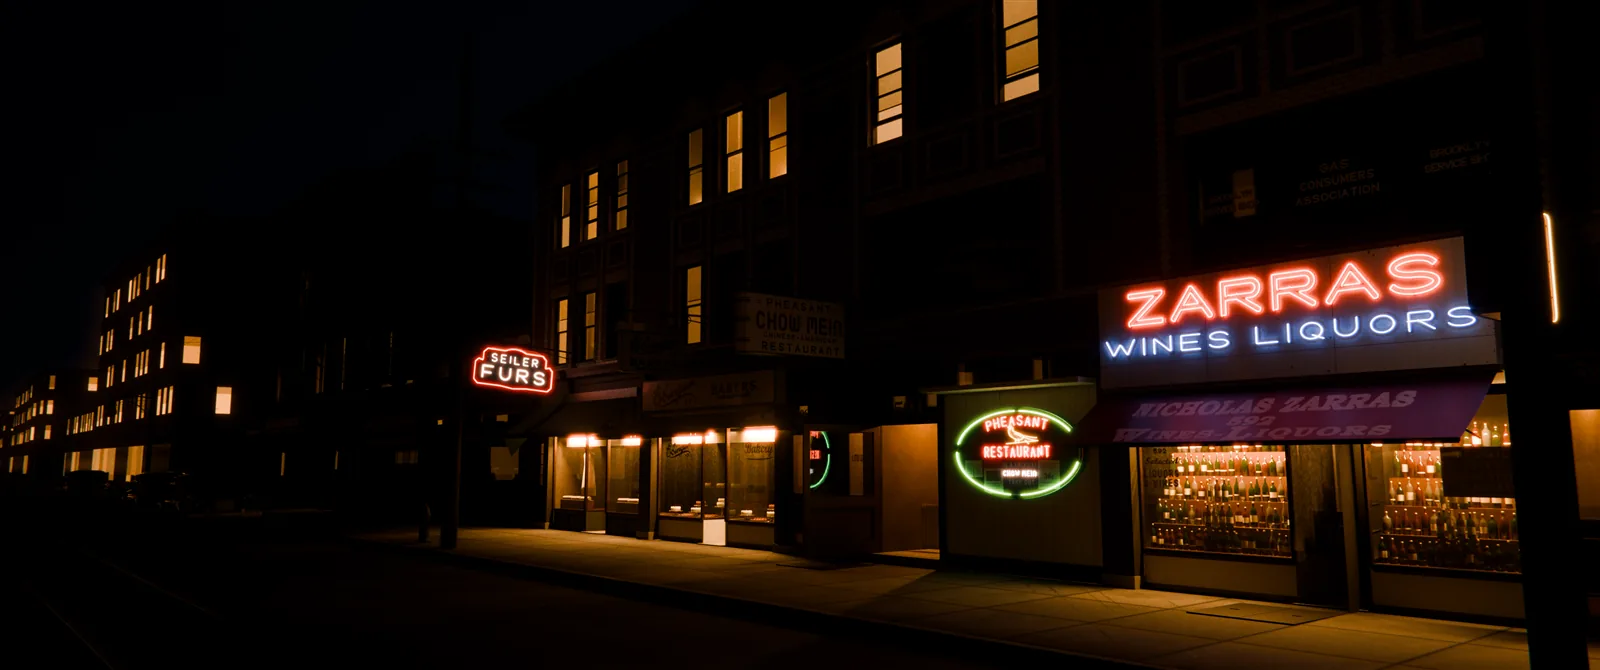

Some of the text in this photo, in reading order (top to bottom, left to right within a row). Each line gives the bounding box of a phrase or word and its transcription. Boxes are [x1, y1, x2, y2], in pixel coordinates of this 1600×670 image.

[1319, 158, 1350, 174] GAS
[1424, 157, 1468, 173] SERVICE
[1299, 168, 1375, 192] CONSUMERS
[1295, 181, 1380, 207] ASSOCIATION
[1125, 252, 1443, 328] ZARRAS
[766, 298, 831, 313] PHEASANT
[756, 310, 843, 337] CHOW MEIN
[1105, 306, 1477, 357] WINES LIQUORS
[762, 341, 839, 356] RESTAURANT
[491, 353, 540, 369] SEILER
[480, 364, 545, 387] FURS
[1132, 391, 1417, 417] NICHOLAS ZARRAS
[984, 414, 1049, 433] PHEASANT
[1226, 416, 1277, 427] 592
[744, 443, 775, 455] Bakery
[983, 445, 1050, 459] RESTAURANT
